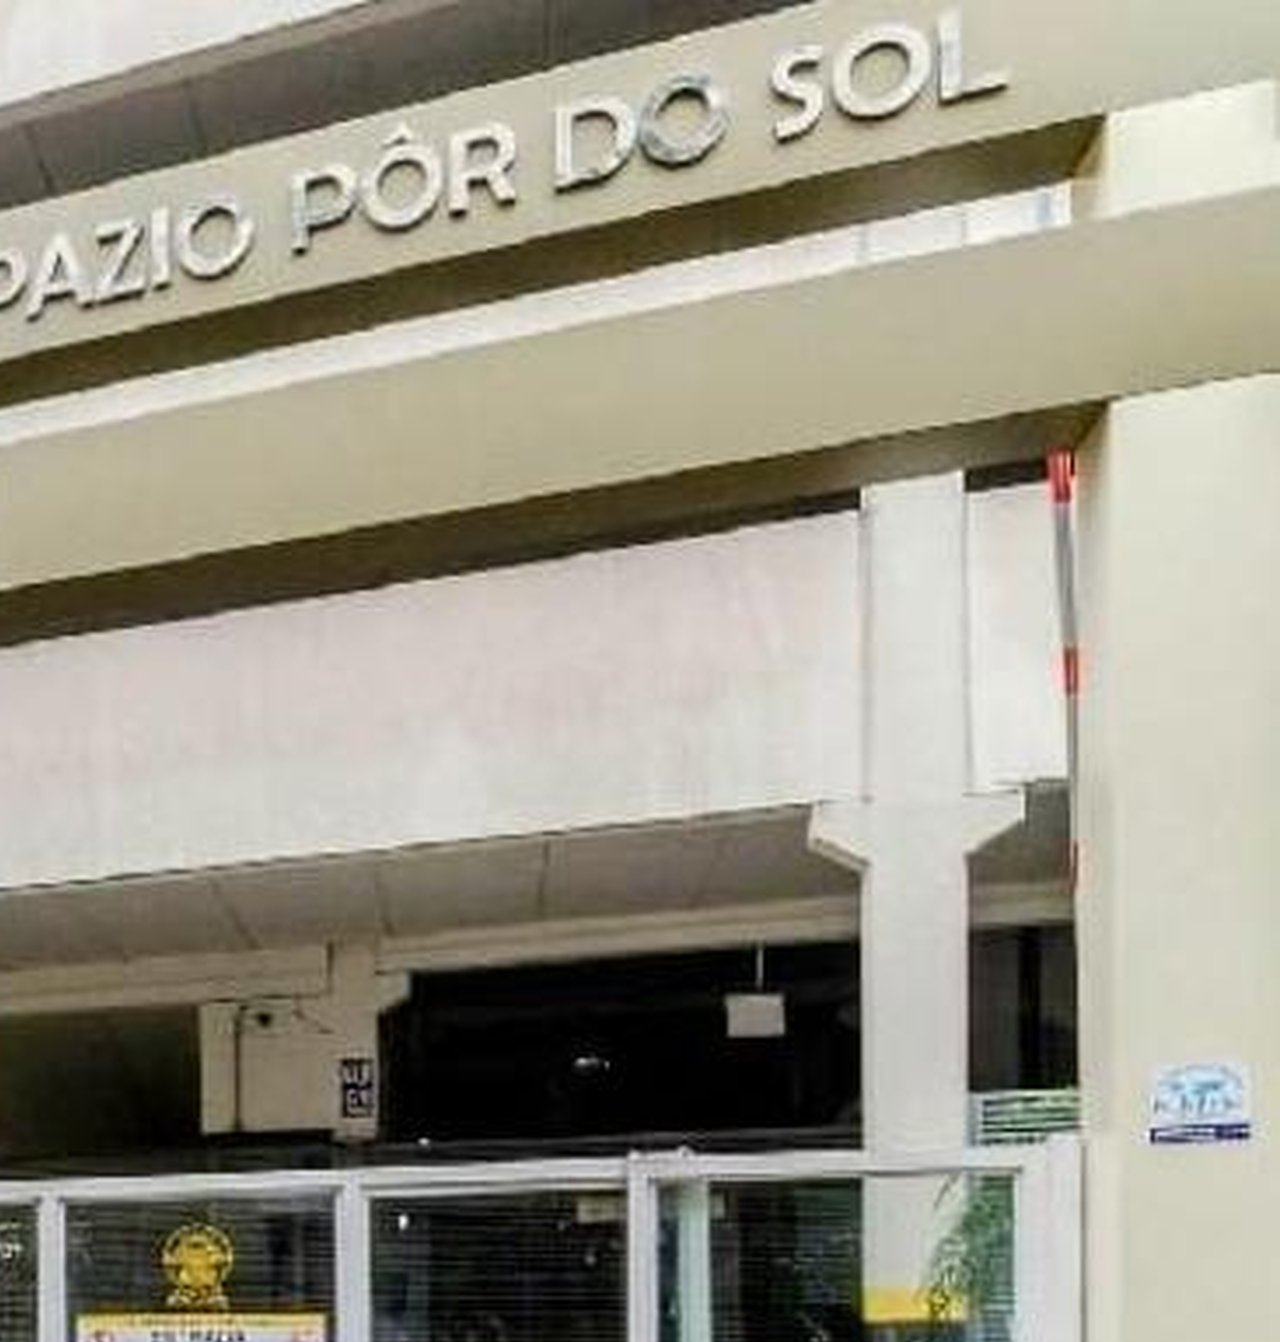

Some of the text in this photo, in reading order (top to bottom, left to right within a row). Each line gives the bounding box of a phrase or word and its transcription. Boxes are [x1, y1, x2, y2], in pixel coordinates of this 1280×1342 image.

[291, 122, 517, 253] PÔR
[554, 71, 728, 194] DO
[770, 8, 1010, 143] SOL
